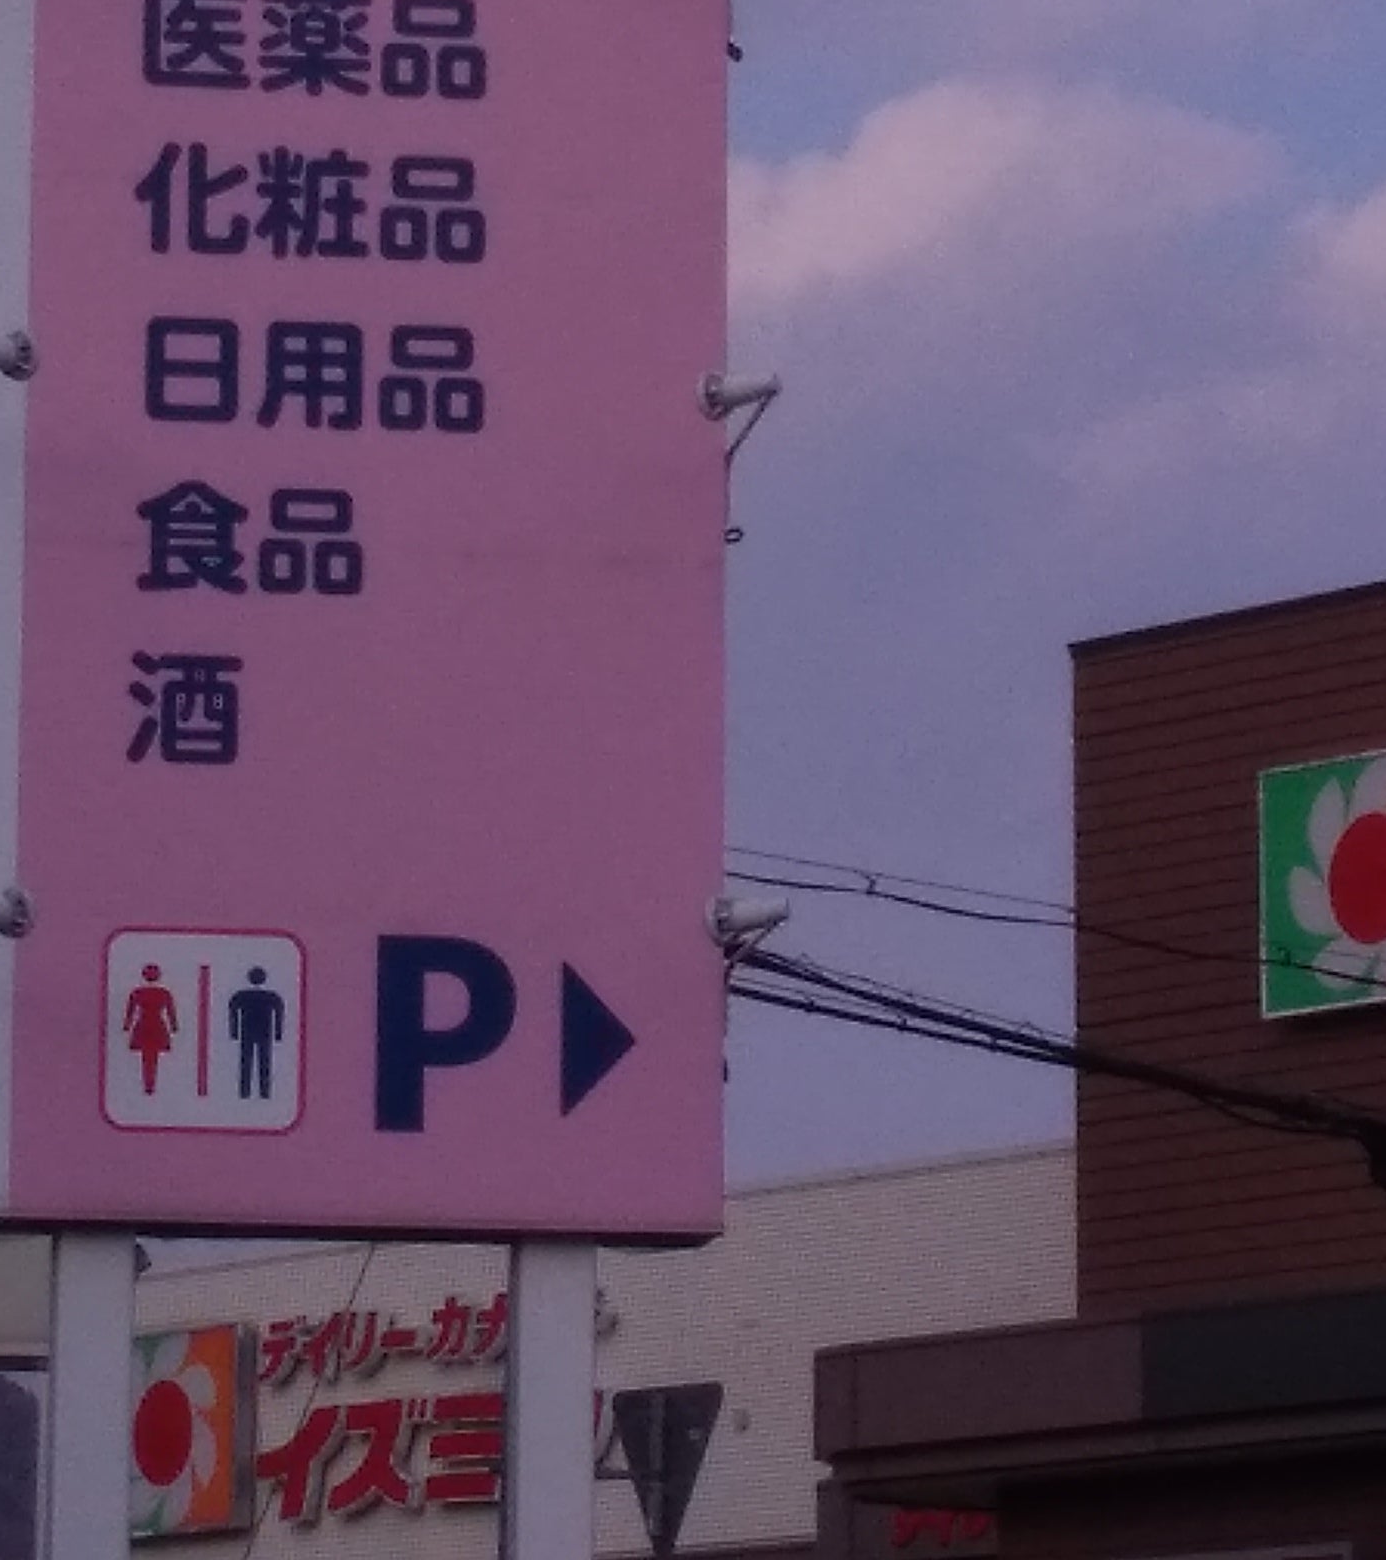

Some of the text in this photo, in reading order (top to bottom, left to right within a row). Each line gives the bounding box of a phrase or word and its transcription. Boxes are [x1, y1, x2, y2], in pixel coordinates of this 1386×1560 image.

[134, 142, 485, 264] 化粧品
[145, 316, 485, 434] 日用品
[137, 479, 363, 595] 食品
[126, 651, 243, 764] 酒
[374, 934, 517, 1133] P
[254, 1391, 608, 1524] イズミ
